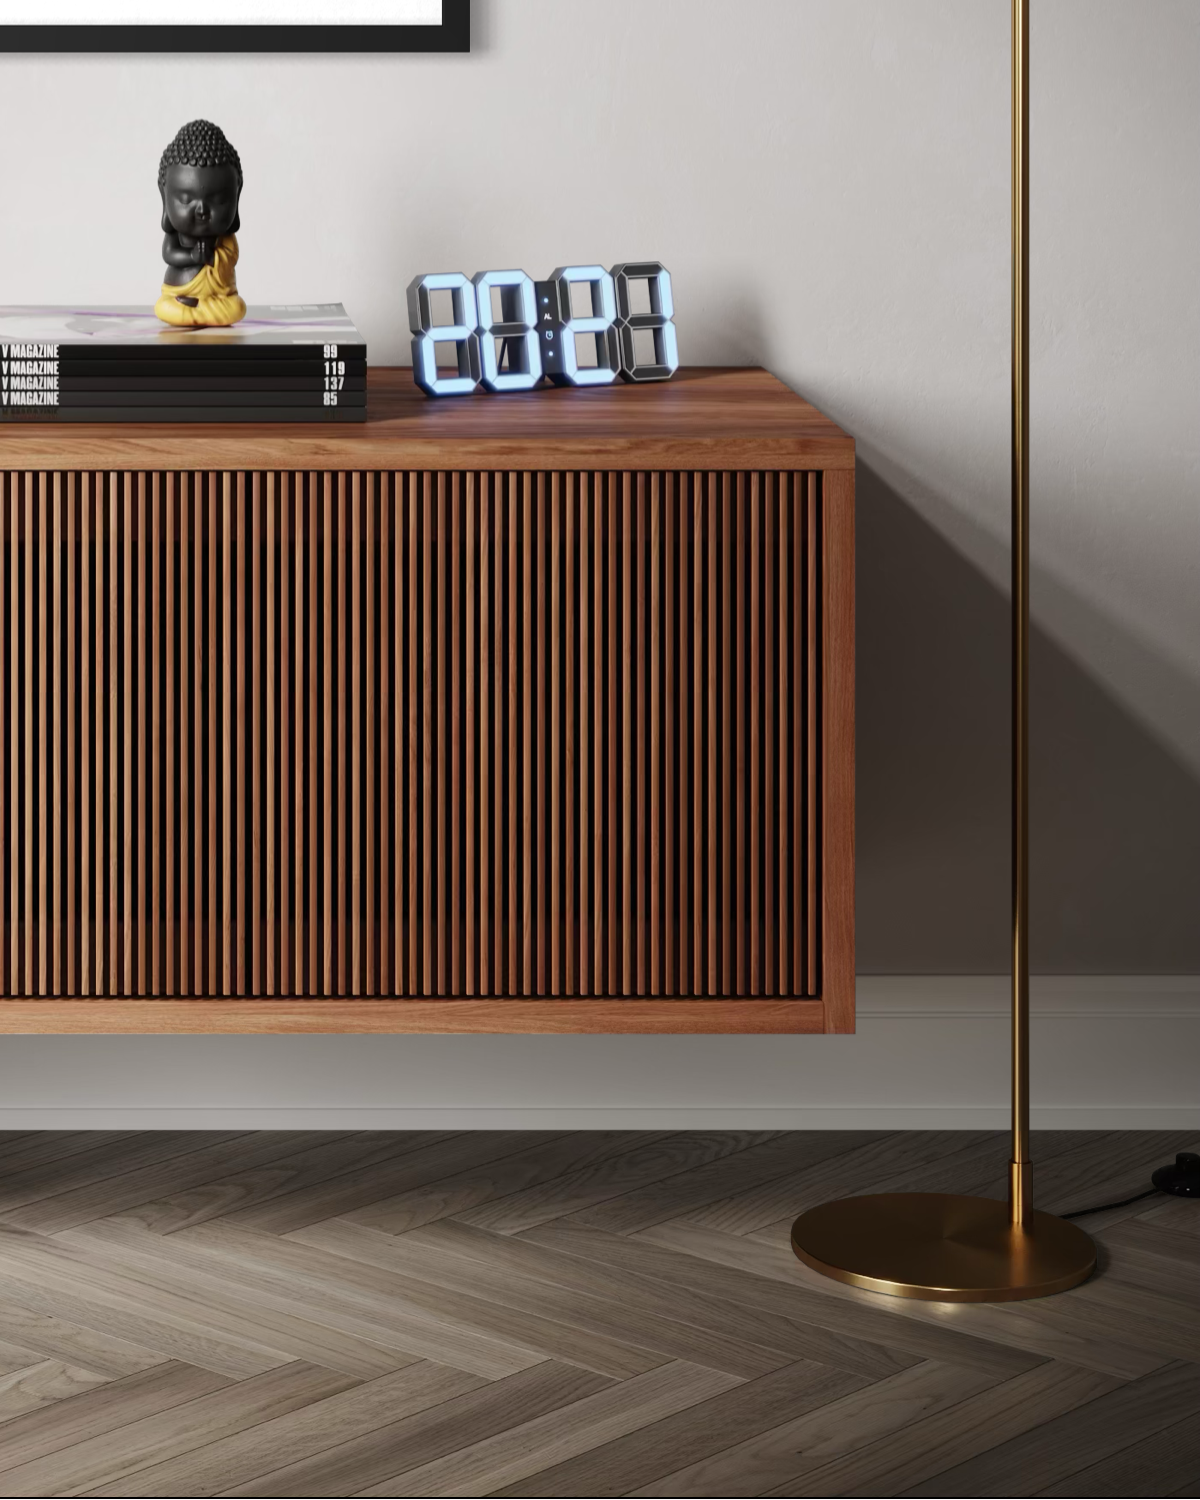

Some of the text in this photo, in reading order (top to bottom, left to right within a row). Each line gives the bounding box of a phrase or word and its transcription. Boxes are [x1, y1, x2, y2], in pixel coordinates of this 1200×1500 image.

[2, 344, 60, 358] V MAGAZINE
[323, 344, 338, 358] 99
[2, 361, 60, 375] V MAGAZINE
[323, 361, 345, 375] 119
[2, 376, 60, 390] V MAGAZINE
[323, 376, 344, 390] 137
[2, 391, 60, 406] V MAGAZINE
[323, 391, 338, 406] 85
